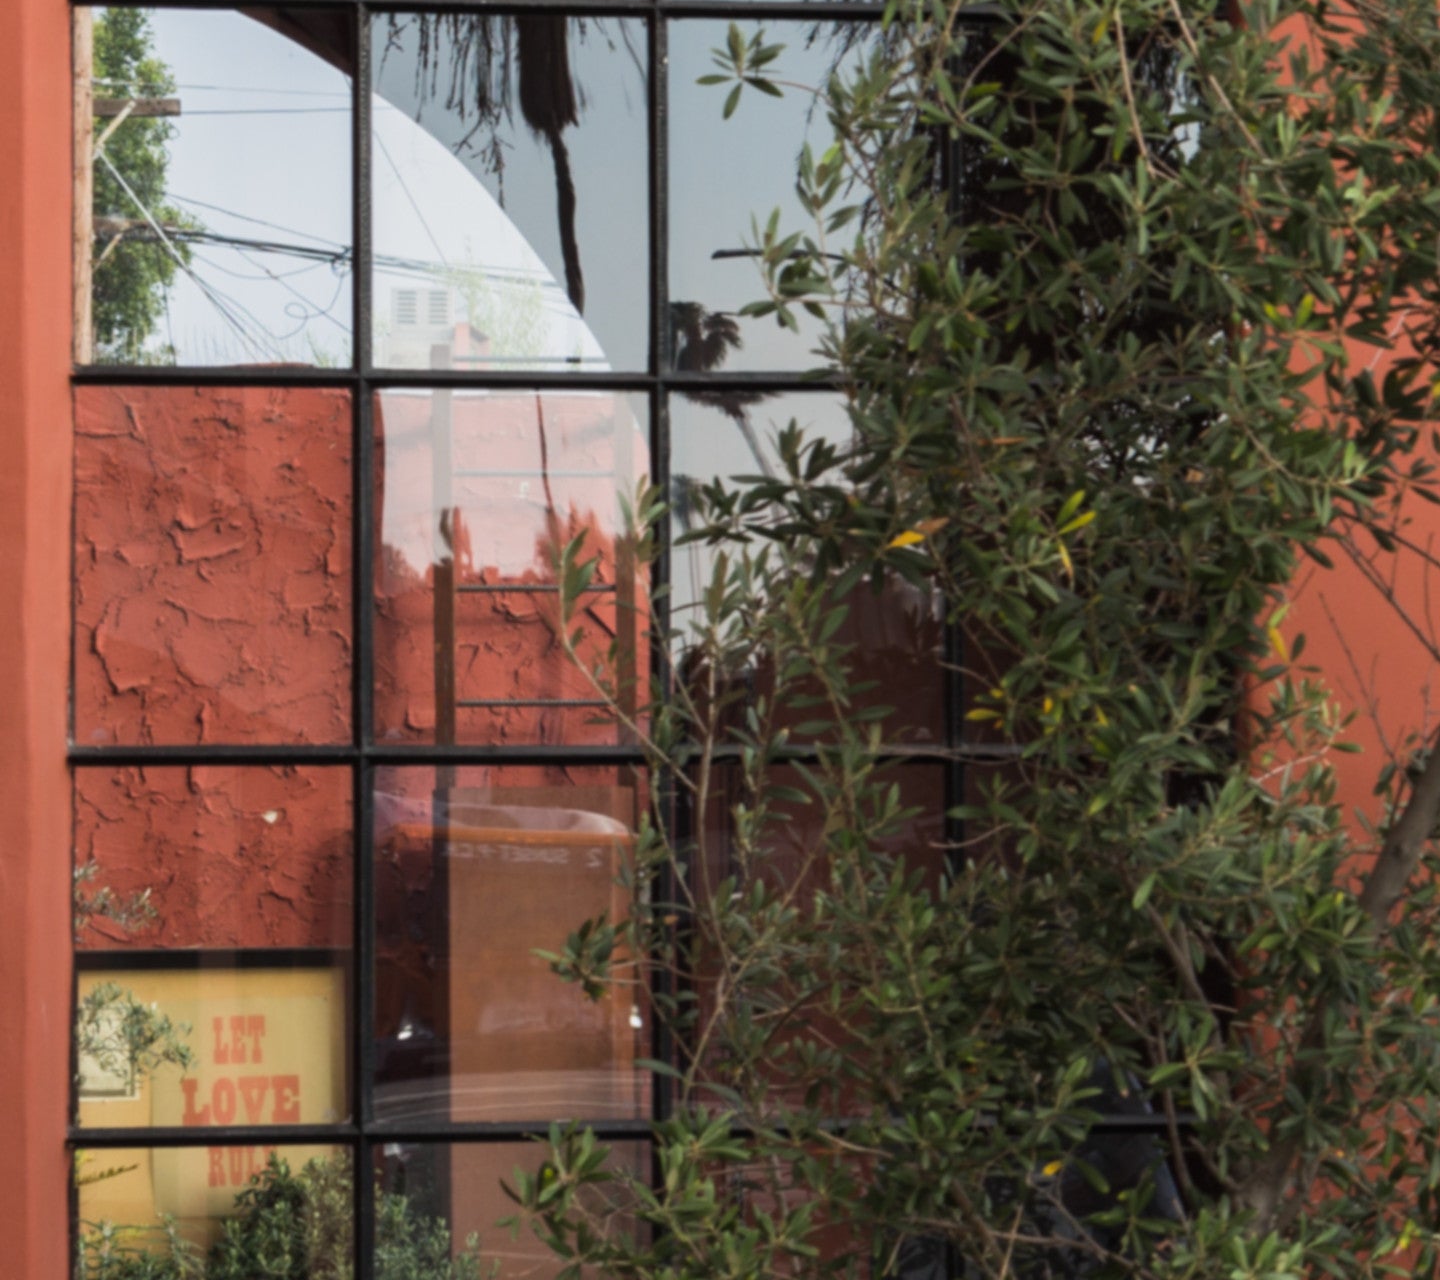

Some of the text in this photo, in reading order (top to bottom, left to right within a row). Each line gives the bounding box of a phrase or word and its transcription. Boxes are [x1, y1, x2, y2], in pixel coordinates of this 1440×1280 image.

[212, 1015, 266, 1065] LET
[180, 1074, 300, 1126] LOVE
[208, 1147, 277, 1188] RUL
